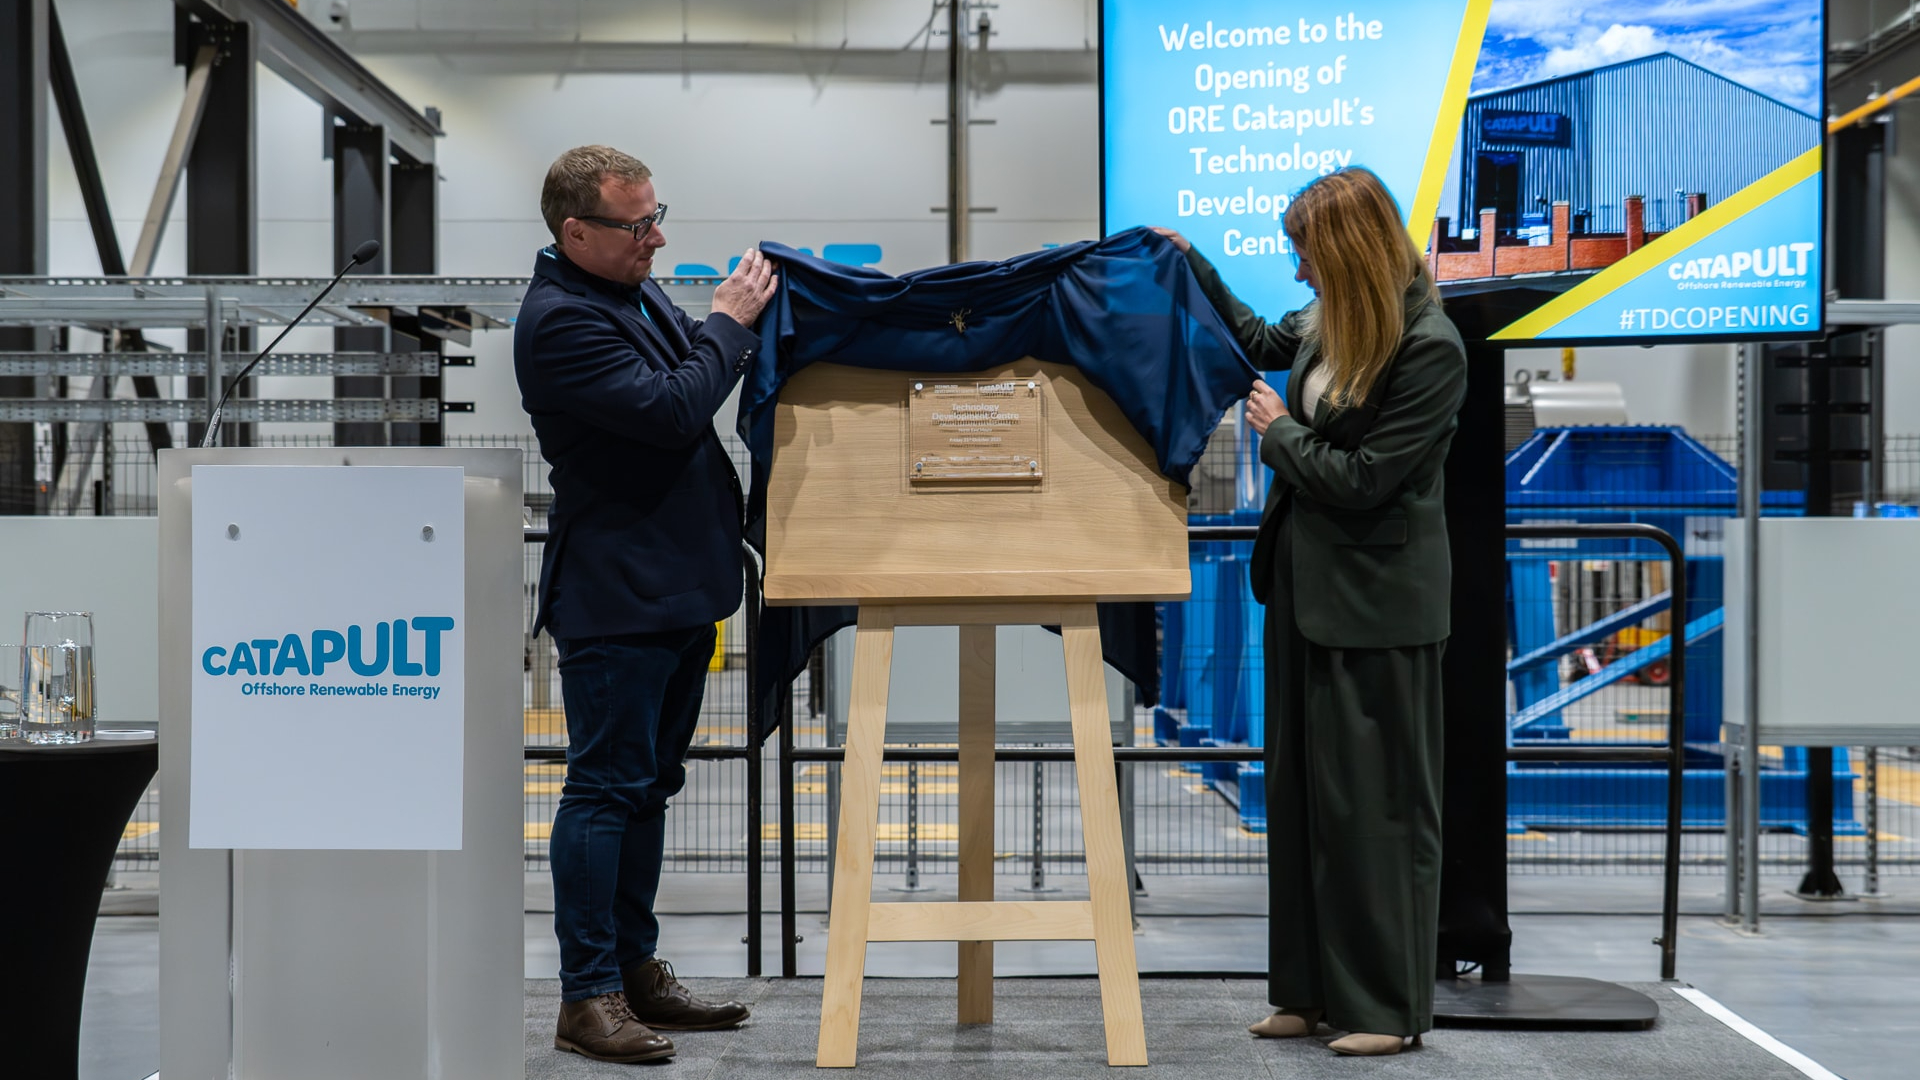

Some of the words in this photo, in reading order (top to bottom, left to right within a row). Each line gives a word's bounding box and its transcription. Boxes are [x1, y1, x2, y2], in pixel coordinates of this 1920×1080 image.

[1158, 20, 1291, 52] Welcome
[1298, 17, 1328, 44] to
[1335, 12, 1384, 42] the
[1194, 60, 1311, 98] Opening
[1316, 54, 1348, 86] of
[1168, 104, 1226, 135] ORE
[1232, 97, 1376, 137] Catapult's
[1483, 113, 1560, 133] CATAPULT
[1189, 141, 1353, 176] Technology
[1177, 185, 1295, 221] Develop
[1668, 242, 1814, 281] CATAPULT
[1676, 280, 1720, 291] Offshore
[1720, 279, 1772, 290] Renewable
[1773, 279, 1807, 290] Energy
[1619, 303, 1810, 331] #TDCOPENING
[931, 412, 990, 421] Development
[952, 403, 1000, 412] Technology
[201, 616, 455, 677] CATAPULT
[241, 682, 306, 697] Offshore
[309, 682, 388, 697] Renewable
[391, 683, 441, 699] Energy
